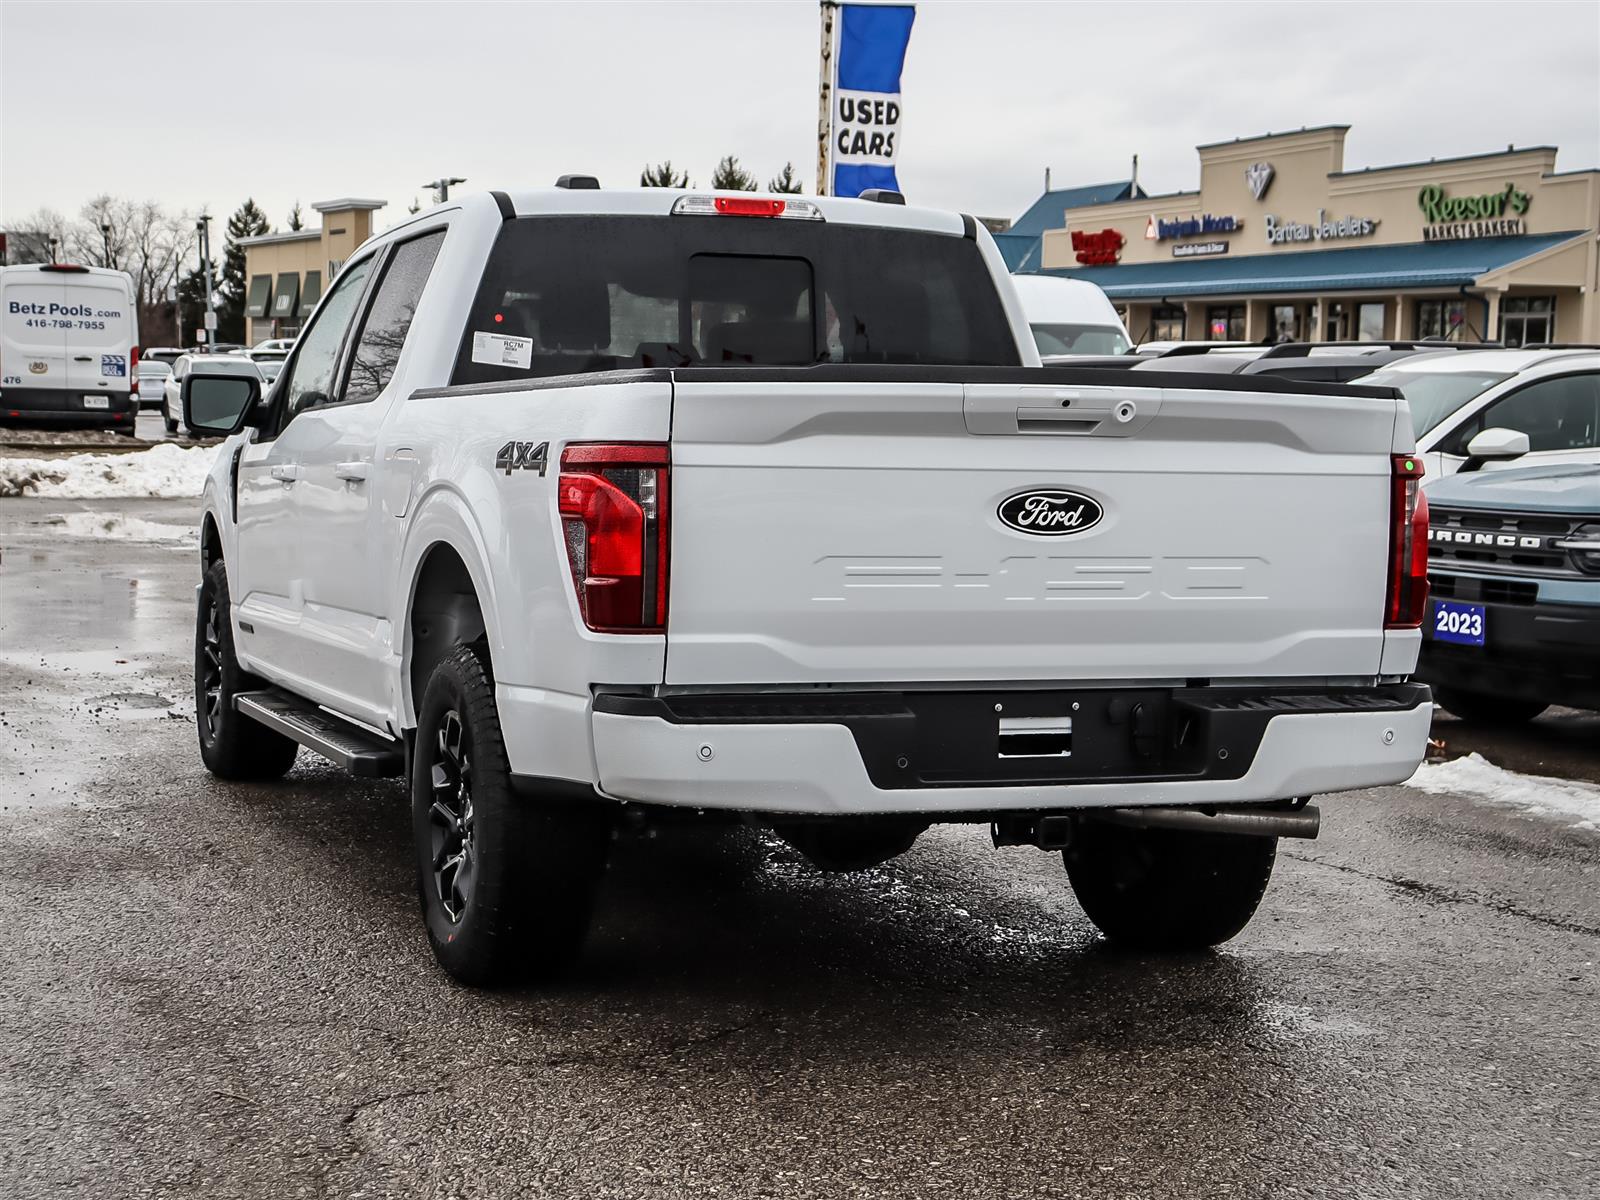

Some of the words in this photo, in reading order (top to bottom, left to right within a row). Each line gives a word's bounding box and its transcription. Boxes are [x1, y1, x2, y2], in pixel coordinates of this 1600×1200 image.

[839, 97, 899, 125] USED
[838, 128, 895, 157] CARS
[1418, 182, 1529, 223] Reesor's
[1313, 207, 1373, 240] Jewellers
[9, 301, 46, 315] Betz
[26, 319, 105, 330] 416-798-7955
[3, 376, 21, 384] 476
[1017, 496, 1083, 527] Ford
[1436, 610, 1482, 636] 2023
